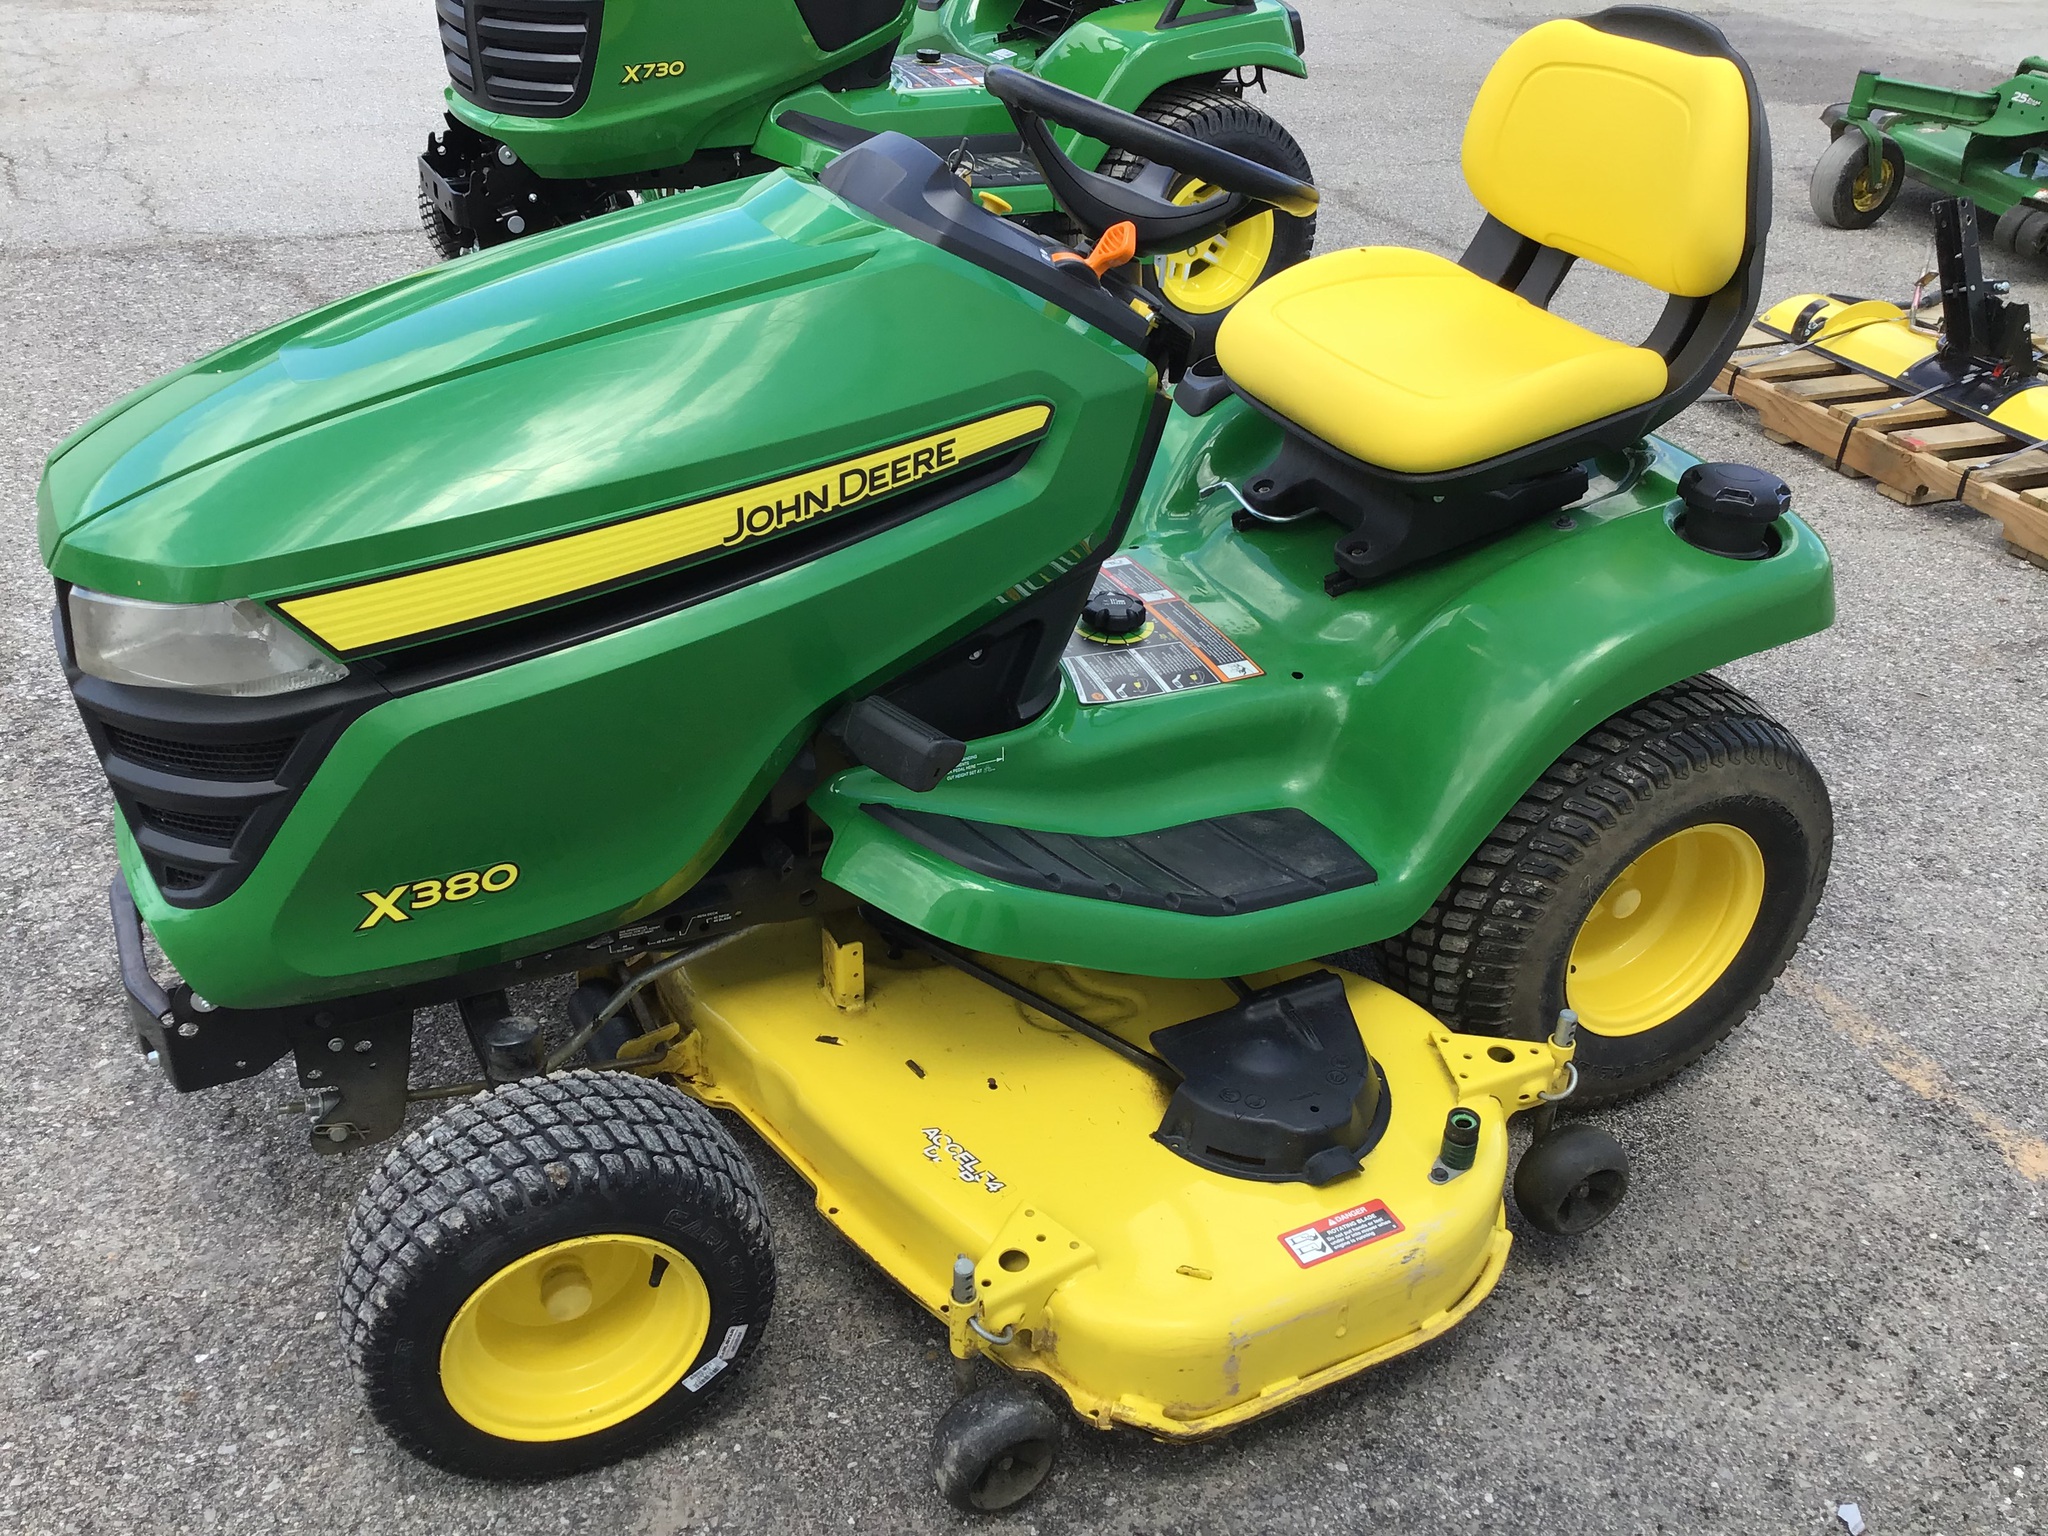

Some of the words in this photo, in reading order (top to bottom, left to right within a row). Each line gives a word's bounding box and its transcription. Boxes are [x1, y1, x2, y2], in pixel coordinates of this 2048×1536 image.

[620, 60, 685, 84] X730
[723, 484, 829, 544] JOHN
[839, 438, 957, 503] DEERE
[355, 862, 519, 931] X380
[1326, 1220, 1357, 1235] ROTATING
[1356, 1213, 1377, 1225] BLADE
[1334, 1206, 1368, 1223] DANGER
